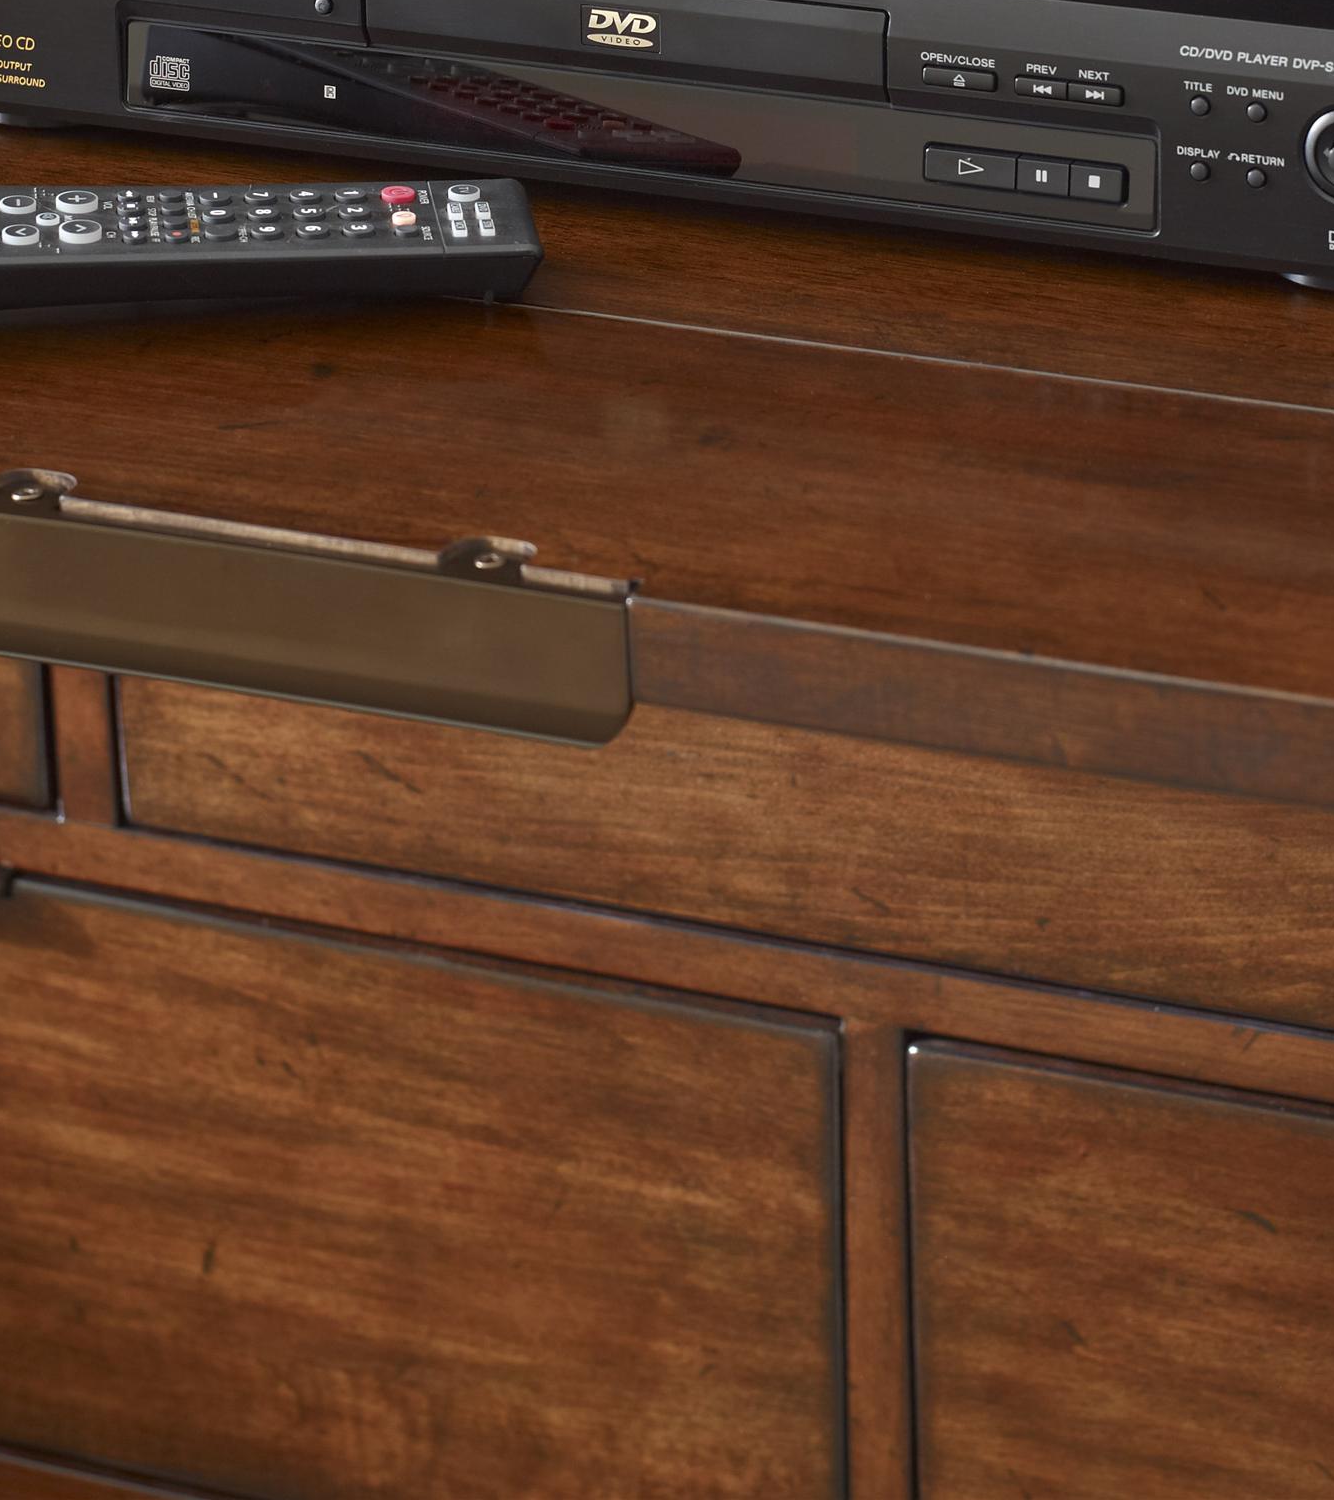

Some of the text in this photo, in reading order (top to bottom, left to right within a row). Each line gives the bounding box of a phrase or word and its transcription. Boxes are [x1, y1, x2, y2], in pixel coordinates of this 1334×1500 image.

[588, 8, 657, 35] DVD
[15, 36, 36, 51] CD
[600, 35, 641, 46] VIDEO
[161, 56, 190, 64] COMPACT
[920, 51, 996, 68] OPEN/CLOSE
[1179, 45, 1233, 61] CD/DVD
[1236, 52, 1288, 68] PLAYER
[1026, 63, 1057, 76] PREV
[1078, 69, 1110, 82] NEXT
[151, 79, 171, 87] DIGITAL
[1183, 80, 1213, 93] TITLE
[1226, 85, 1284, 101] DVD MENU
[1176, 145, 1221, 159] DISPLAY
[1241, 153, 1285, 167] RETURN
[417, 189, 430, 205] POWER
[102, 200, 113, 210] VOL
[106, 231, 117, 239] CH
[421, 225, 433, 241] SOURCE
